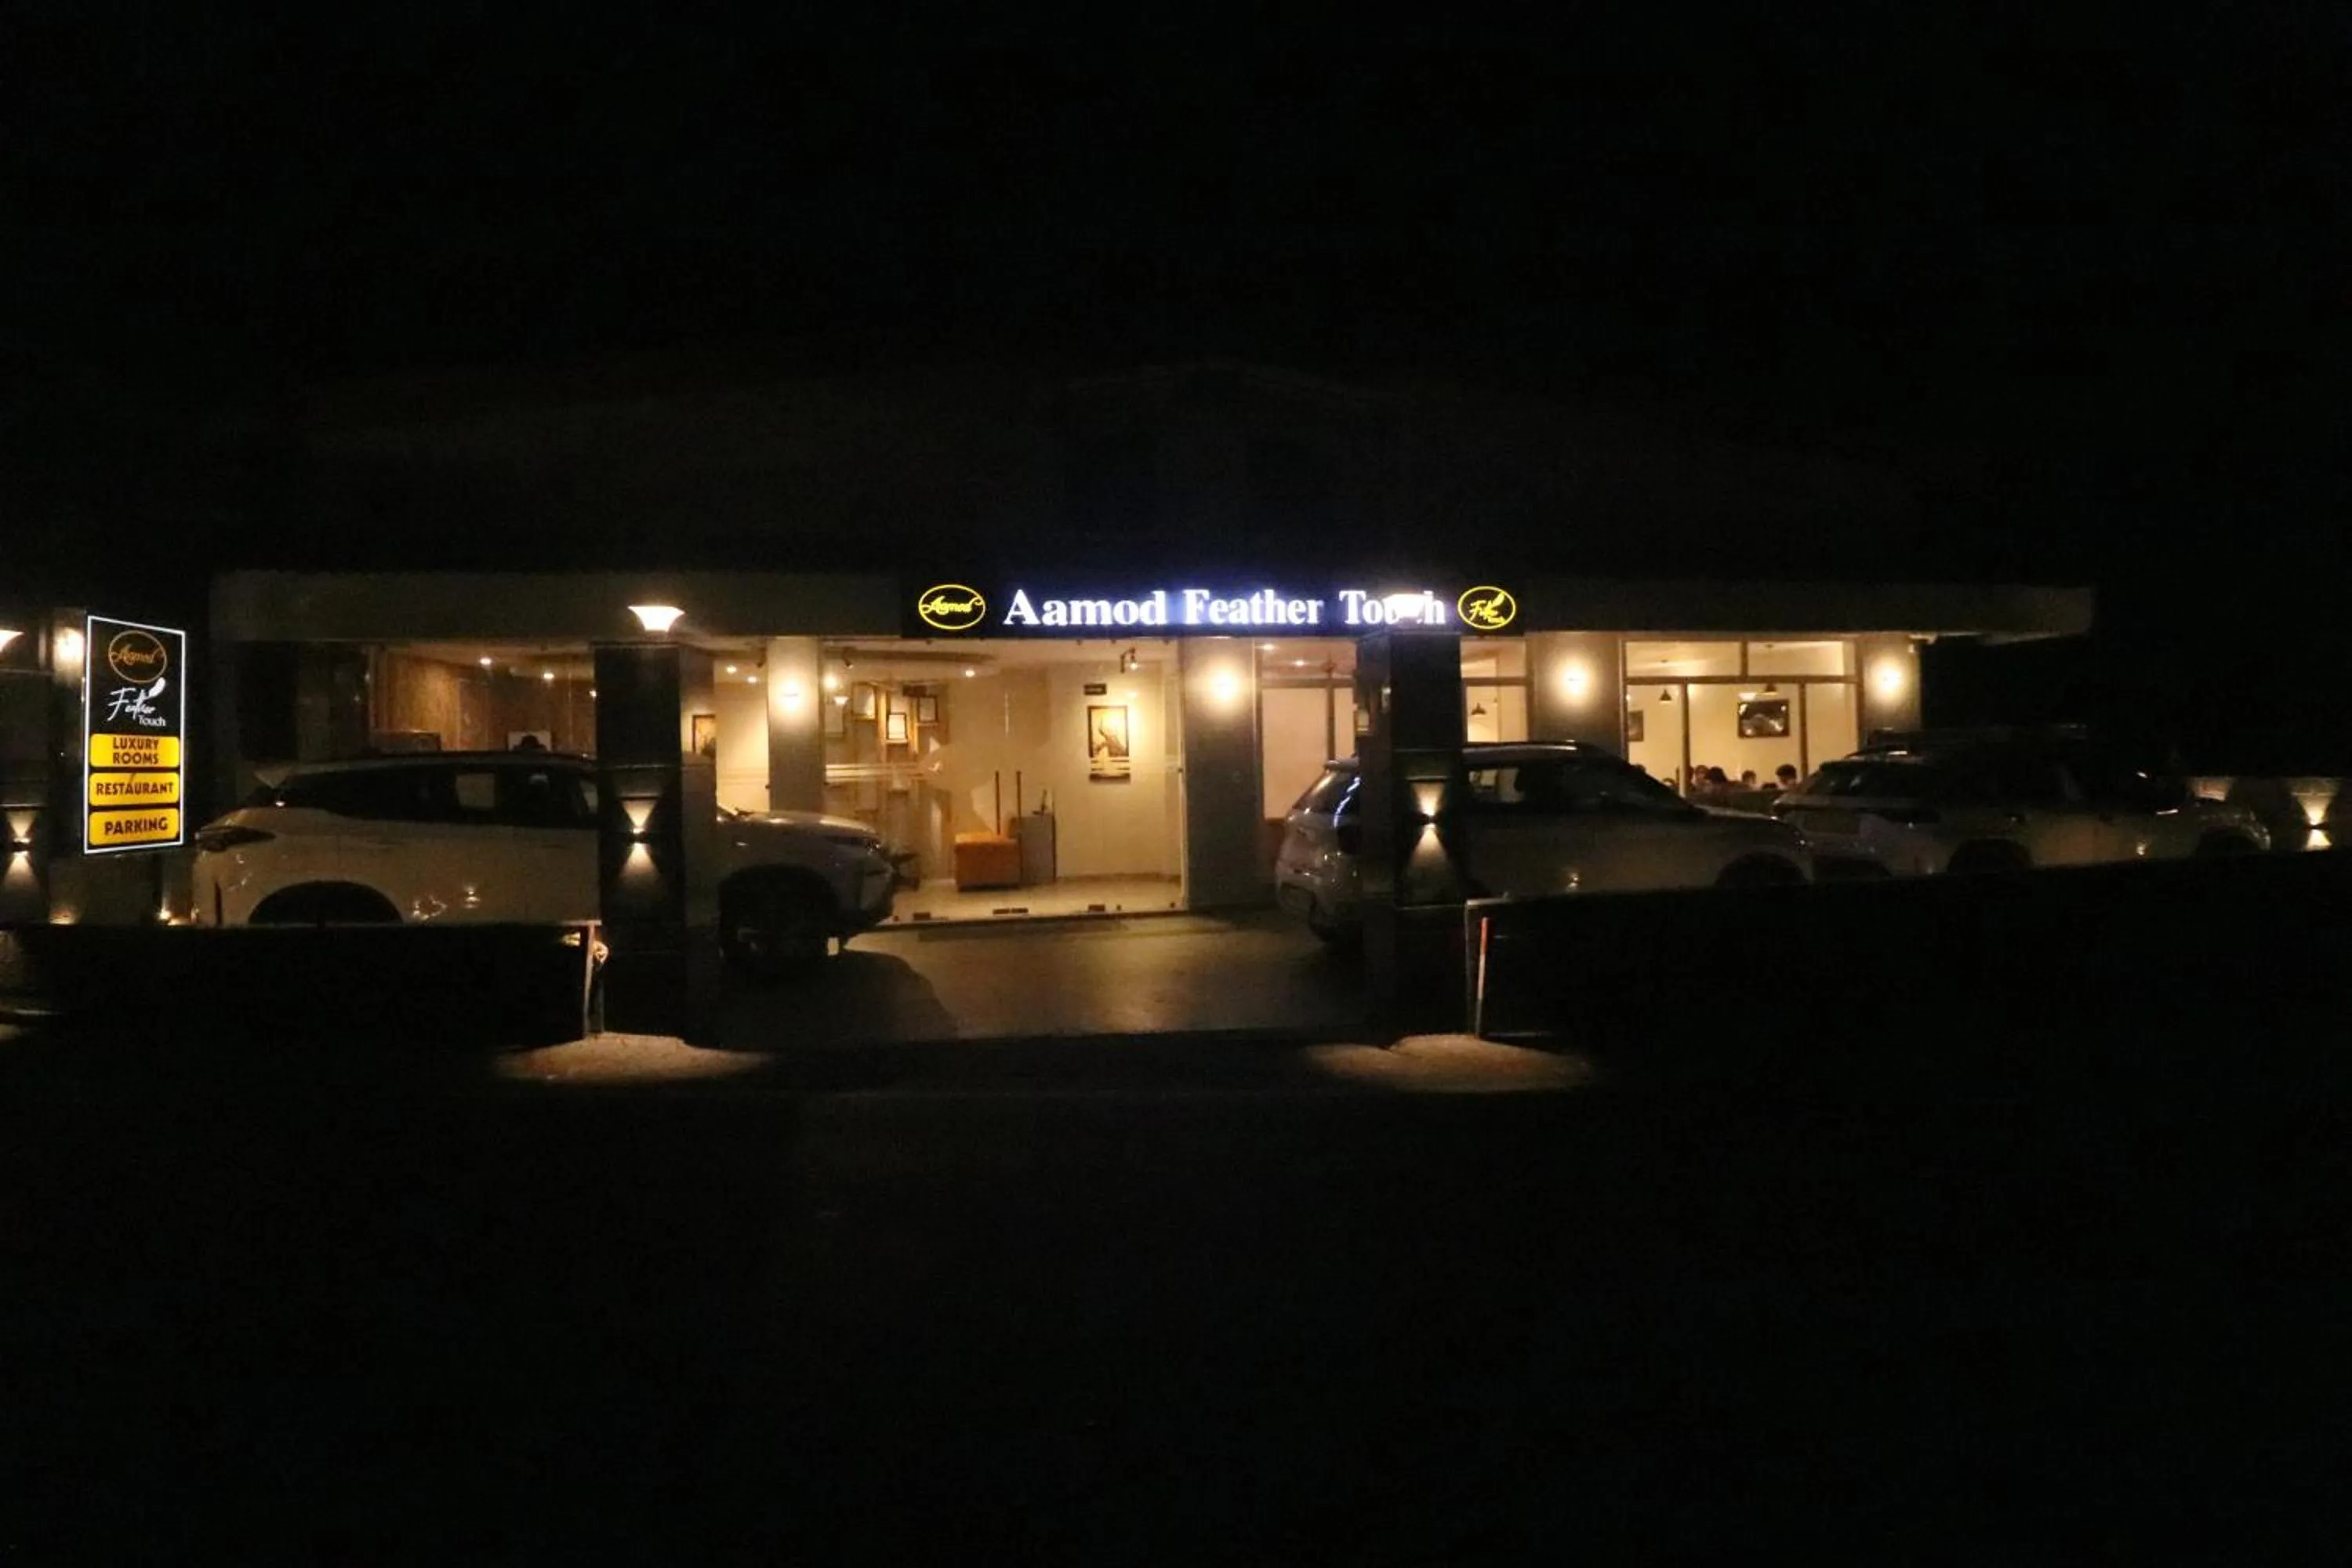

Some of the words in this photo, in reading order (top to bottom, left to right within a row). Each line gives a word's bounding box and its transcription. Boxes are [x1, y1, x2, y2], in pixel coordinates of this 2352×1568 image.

[1004, 589, 1167, 626] Aamod
[1183, 590, 1323, 626] Feather
[1339, 590, 1446, 625] Touh
[139, 715, 166, 727] Touch
[113, 736, 159, 750] LUXURY
[113, 752, 159, 765] ROOMS
[96, 782, 174, 797] RESTAURANT
[104, 817, 168, 836] PARKING
